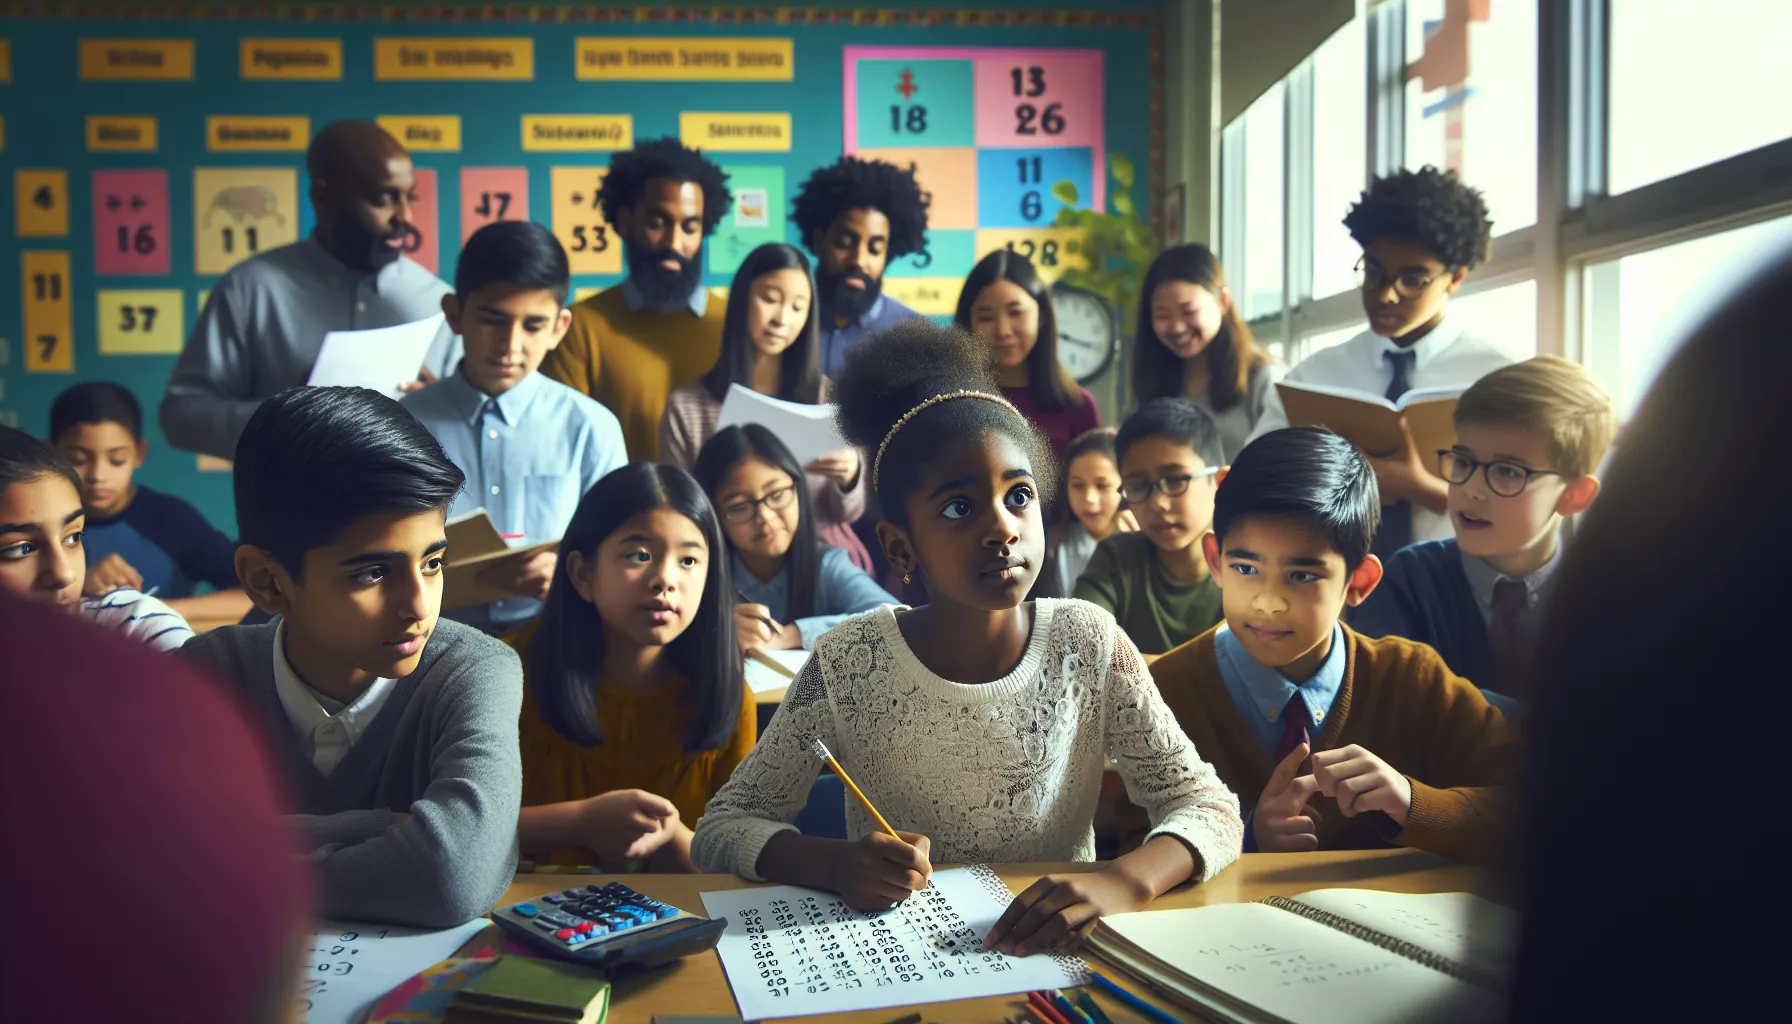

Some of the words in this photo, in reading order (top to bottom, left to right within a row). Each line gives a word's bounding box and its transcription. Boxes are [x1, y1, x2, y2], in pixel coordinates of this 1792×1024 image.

[1011, 66, 1045, 97] 13
[890, 105, 928, 135] 18
[1015, 102, 1066, 135] 26
[1017, 157, 1043, 184] 11
[33, 185, 54, 210] 4
[1020, 191, 1043, 222] 6
[116, 225, 157, 255] 16
[571, 225, 608, 252] 53
[33, 273, 61, 301] 11
[119, 305, 159, 332] 37
[37, 335, 58, 362] 7
